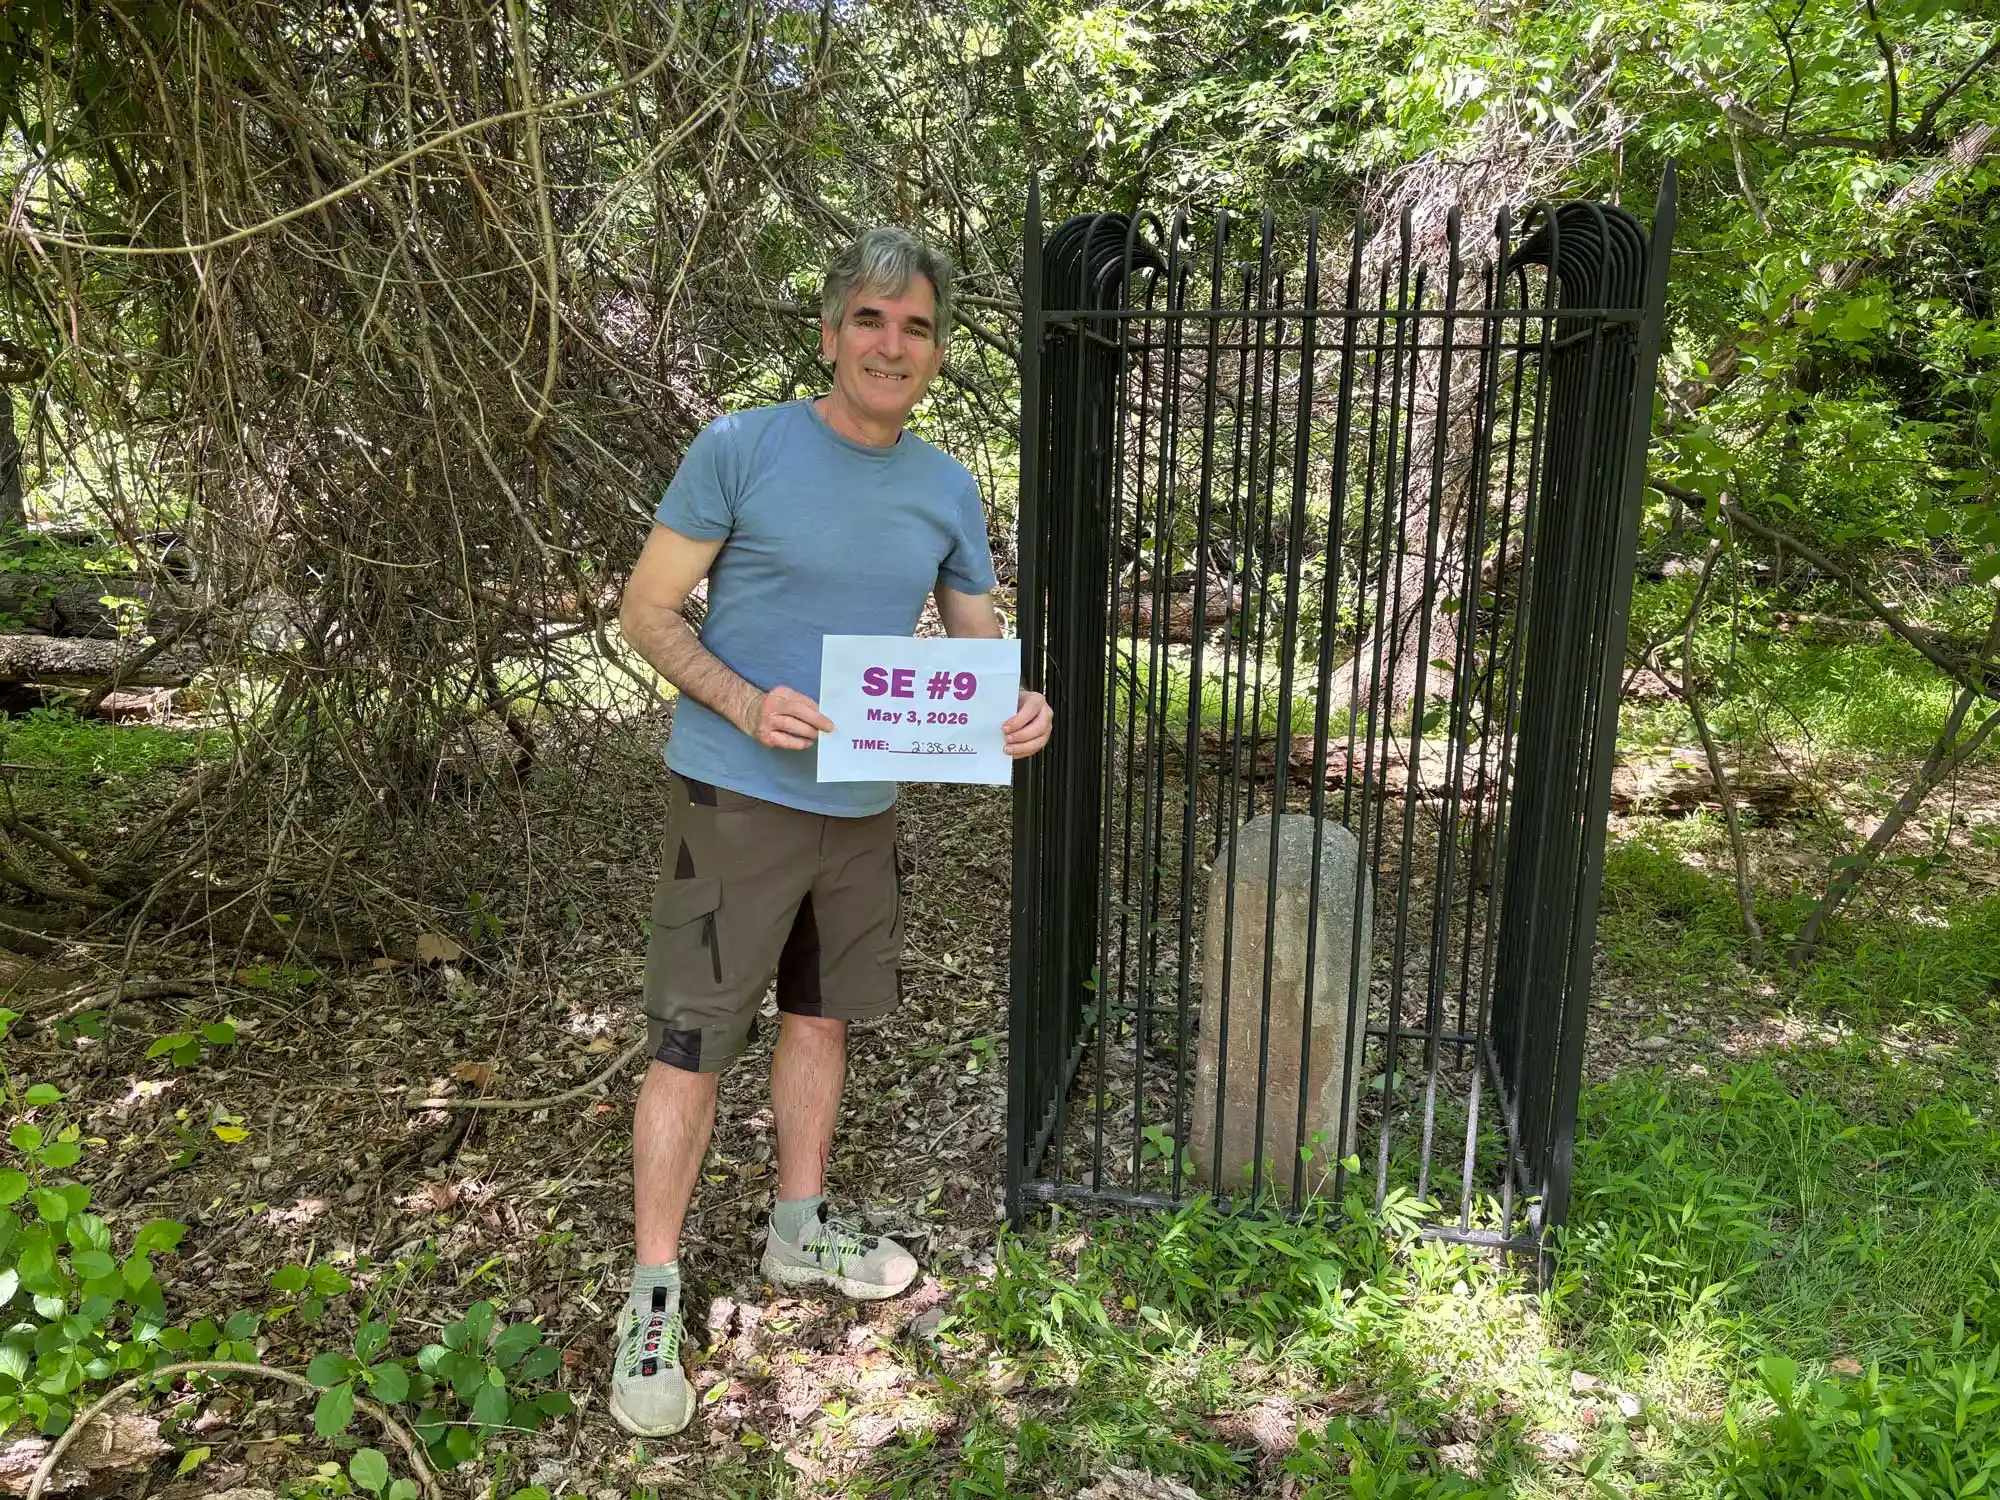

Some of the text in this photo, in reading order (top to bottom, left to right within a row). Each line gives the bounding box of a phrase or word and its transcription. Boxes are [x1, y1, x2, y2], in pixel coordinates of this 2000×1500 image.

[861, 666, 978, 701] SE #9
[867, 708, 969, 726] May 3, 2026
[851, 739, 890, 751] TIME:
[911, 740, 944, 754] 2:38
